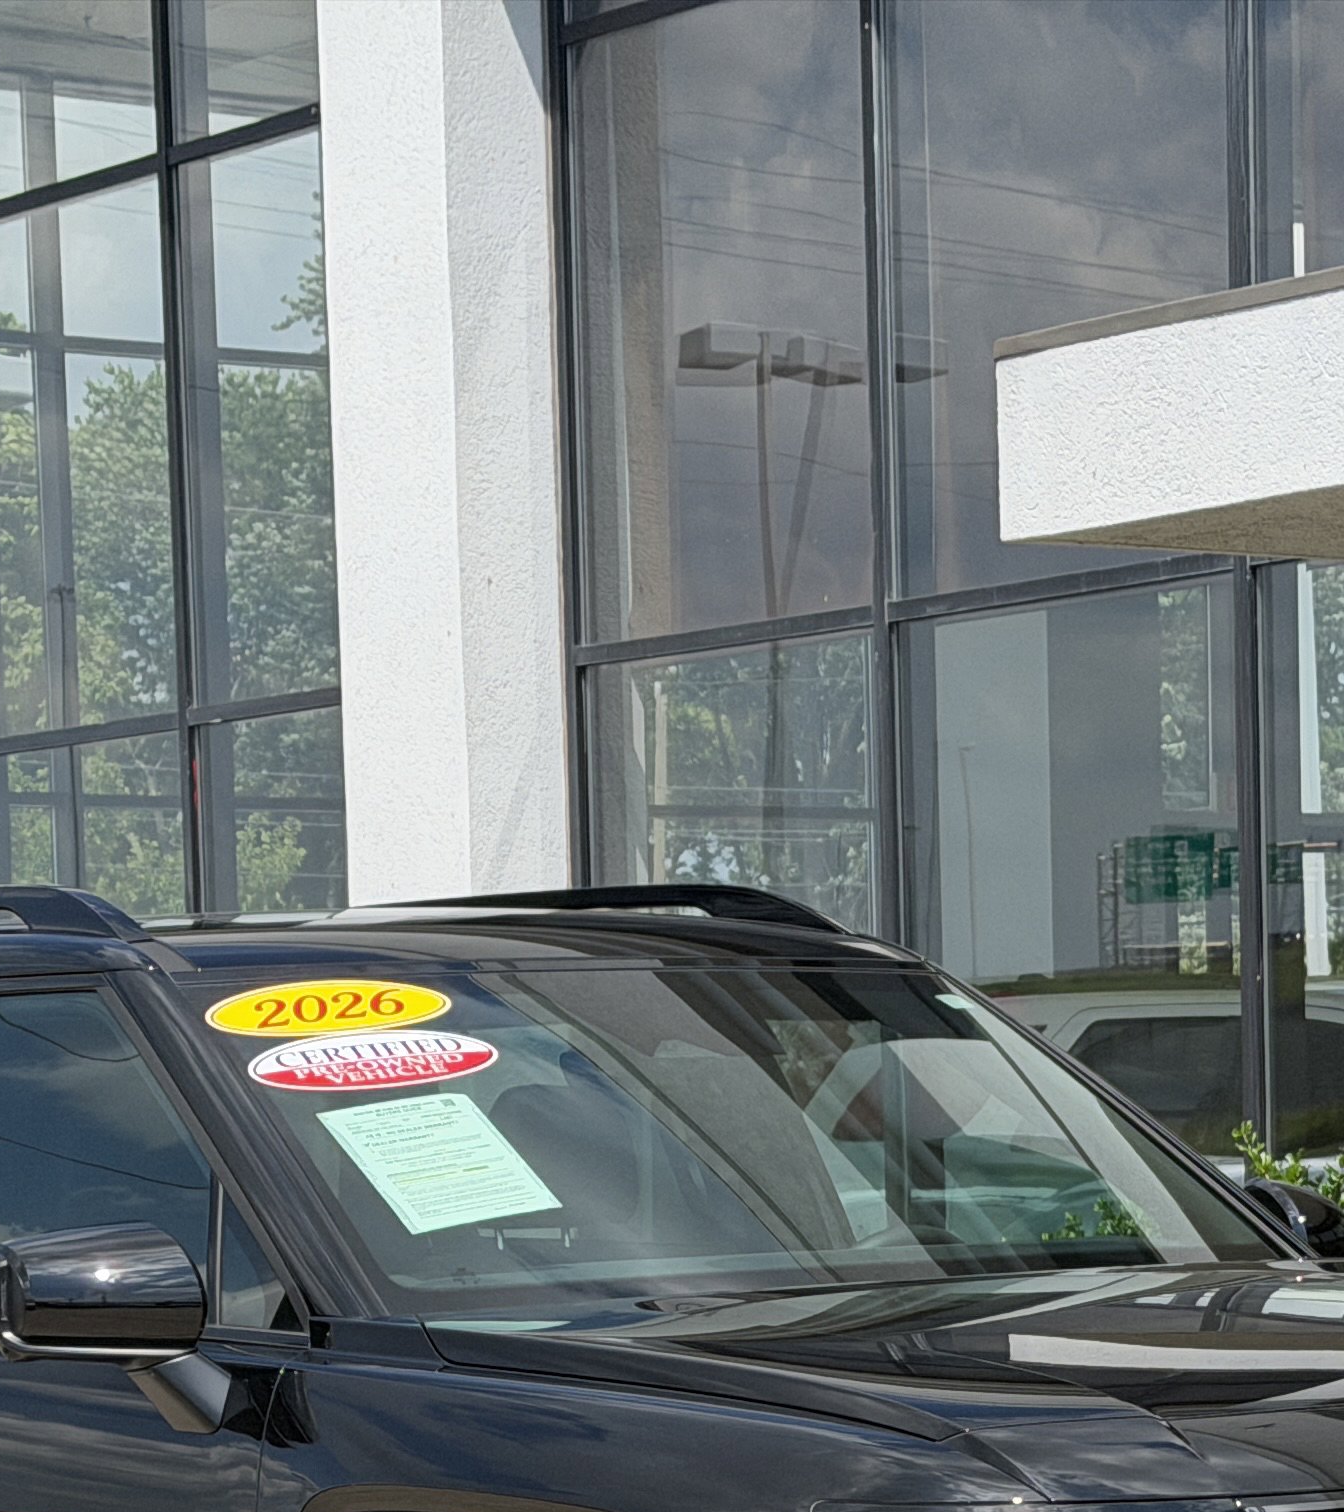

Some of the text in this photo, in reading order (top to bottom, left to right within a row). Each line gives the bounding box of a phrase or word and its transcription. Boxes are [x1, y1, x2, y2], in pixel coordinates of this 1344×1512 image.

[254, 989, 405, 1029] 2026
[275, 1038, 462, 1067] CERTIFIED
[293, 1053, 464, 1079] PRE-OWNED
[326, 1063, 449, 1084] VEHICLE
